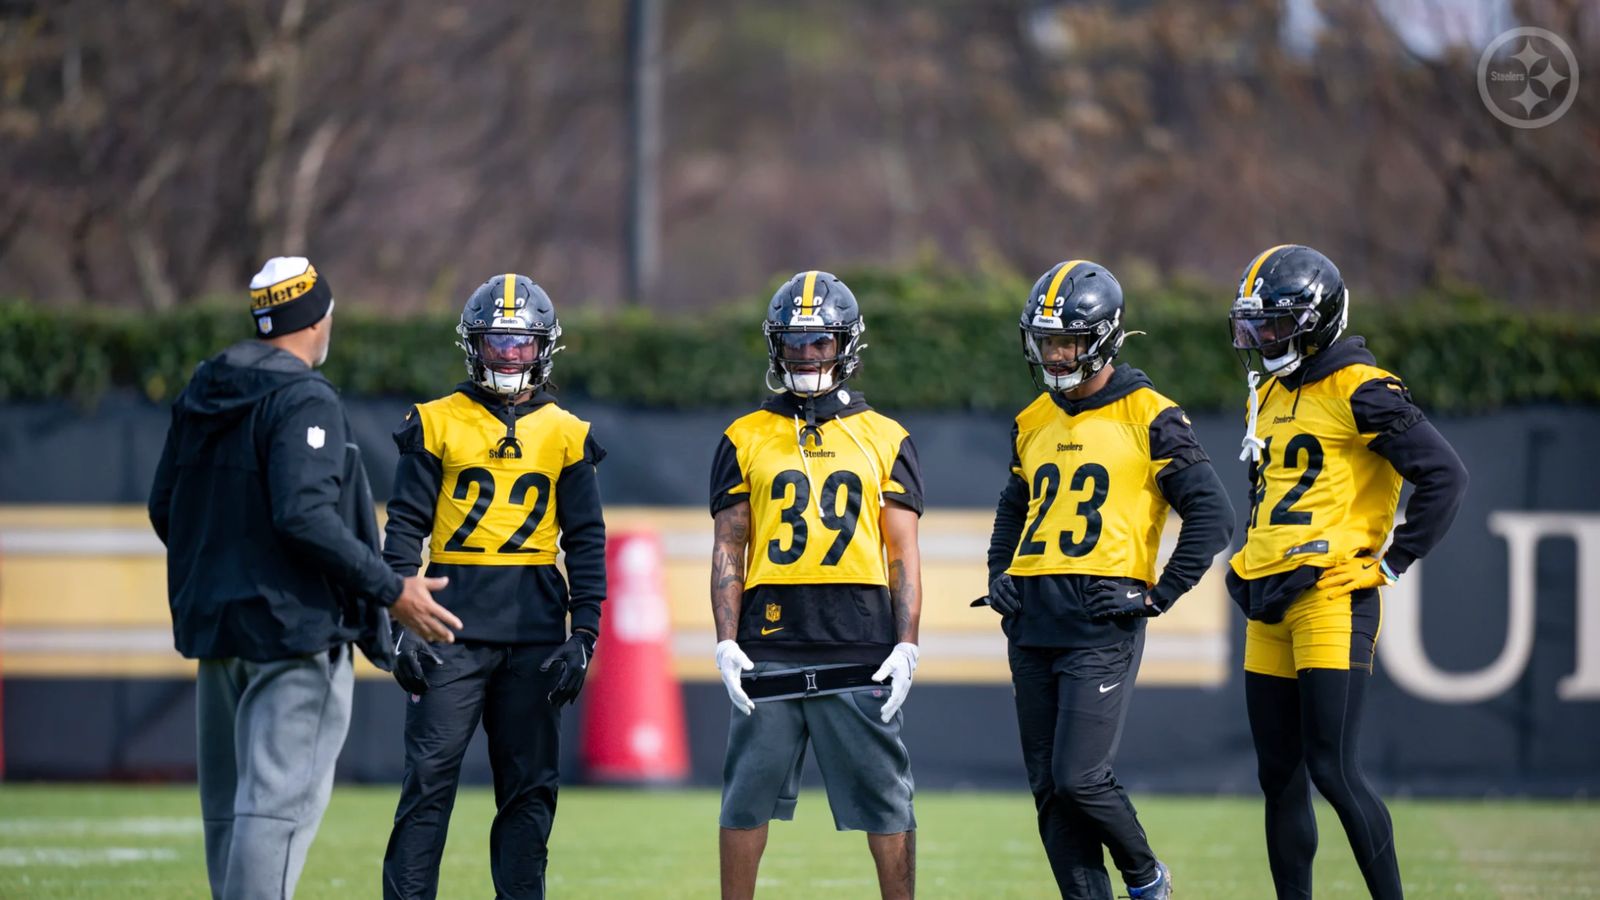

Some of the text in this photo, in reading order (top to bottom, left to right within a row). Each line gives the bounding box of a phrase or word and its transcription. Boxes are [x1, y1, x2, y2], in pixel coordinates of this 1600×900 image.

[803, 448, 836, 458] Steelers
[1056, 441, 1084, 452] Steelers
[443, 466, 552, 554] 22
[767, 469, 863, 567] 39
[1018, 462, 1110, 558] 23
